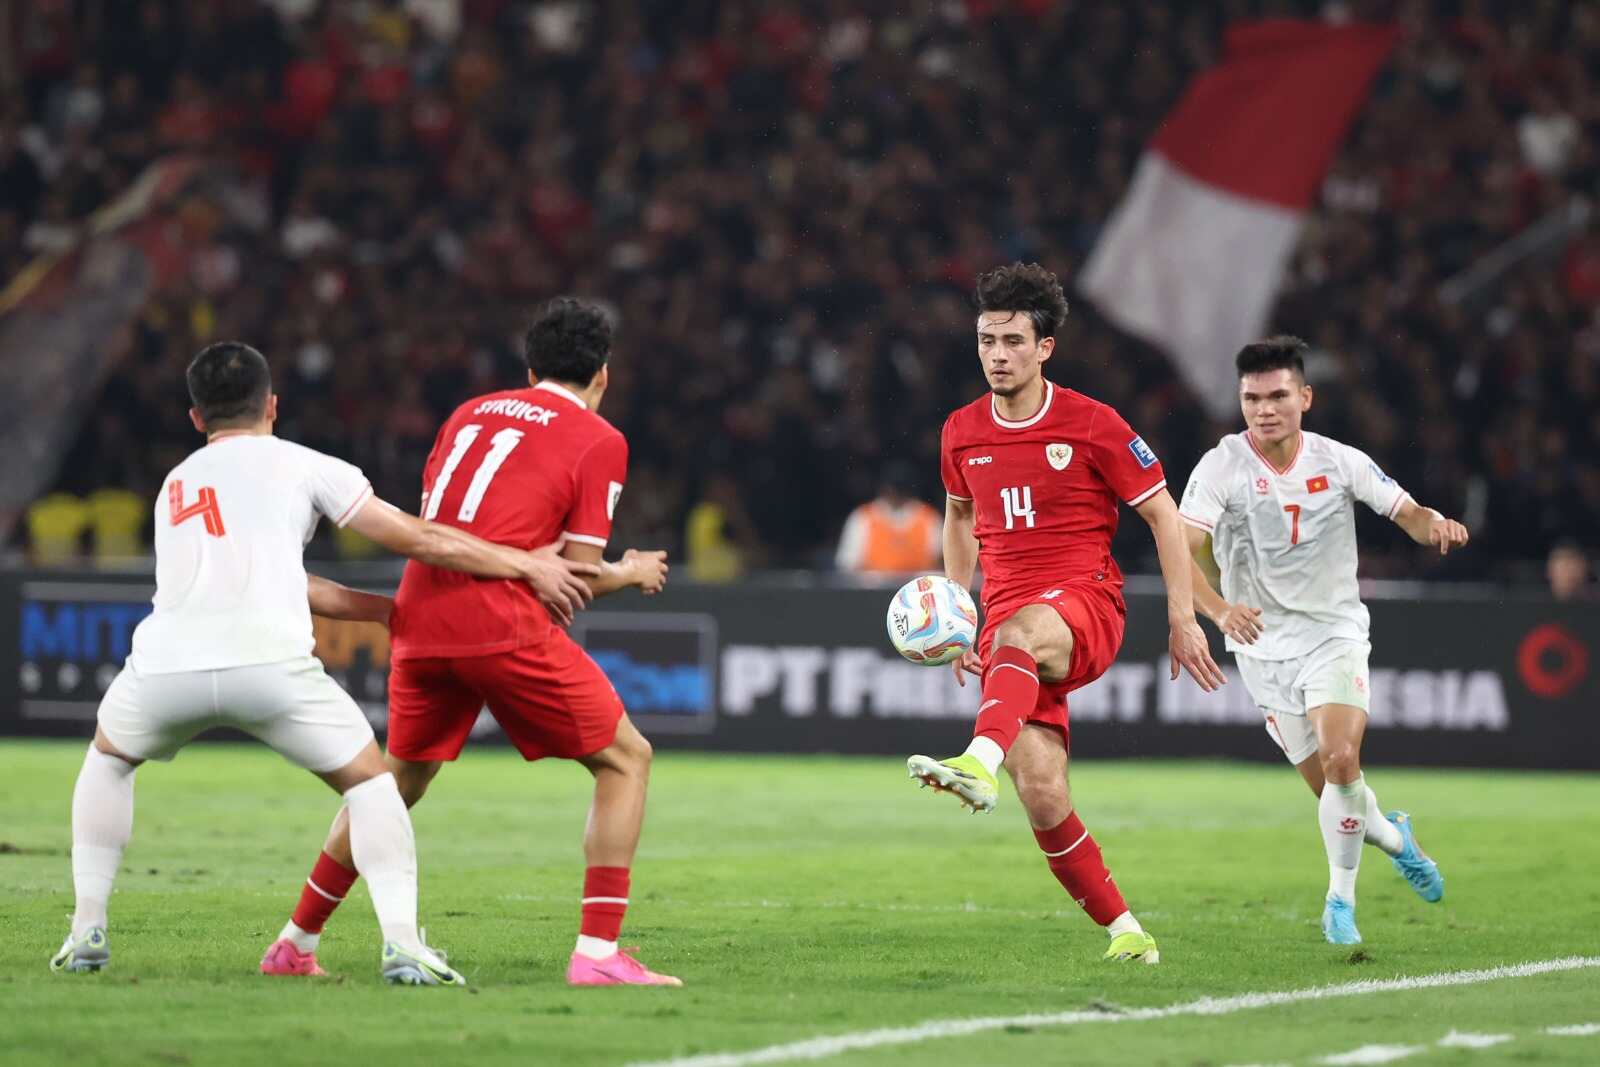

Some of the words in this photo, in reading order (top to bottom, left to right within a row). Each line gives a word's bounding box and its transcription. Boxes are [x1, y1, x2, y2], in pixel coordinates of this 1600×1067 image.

[474, 398, 559, 427] STRUICK
[425, 424, 526, 523] 11
[168, 479, 226, 538] 4
[1000, 486, 1037, 530] 14
[1284, 504, 1301, 545] 7
[721, 644, 827, 719] PT
